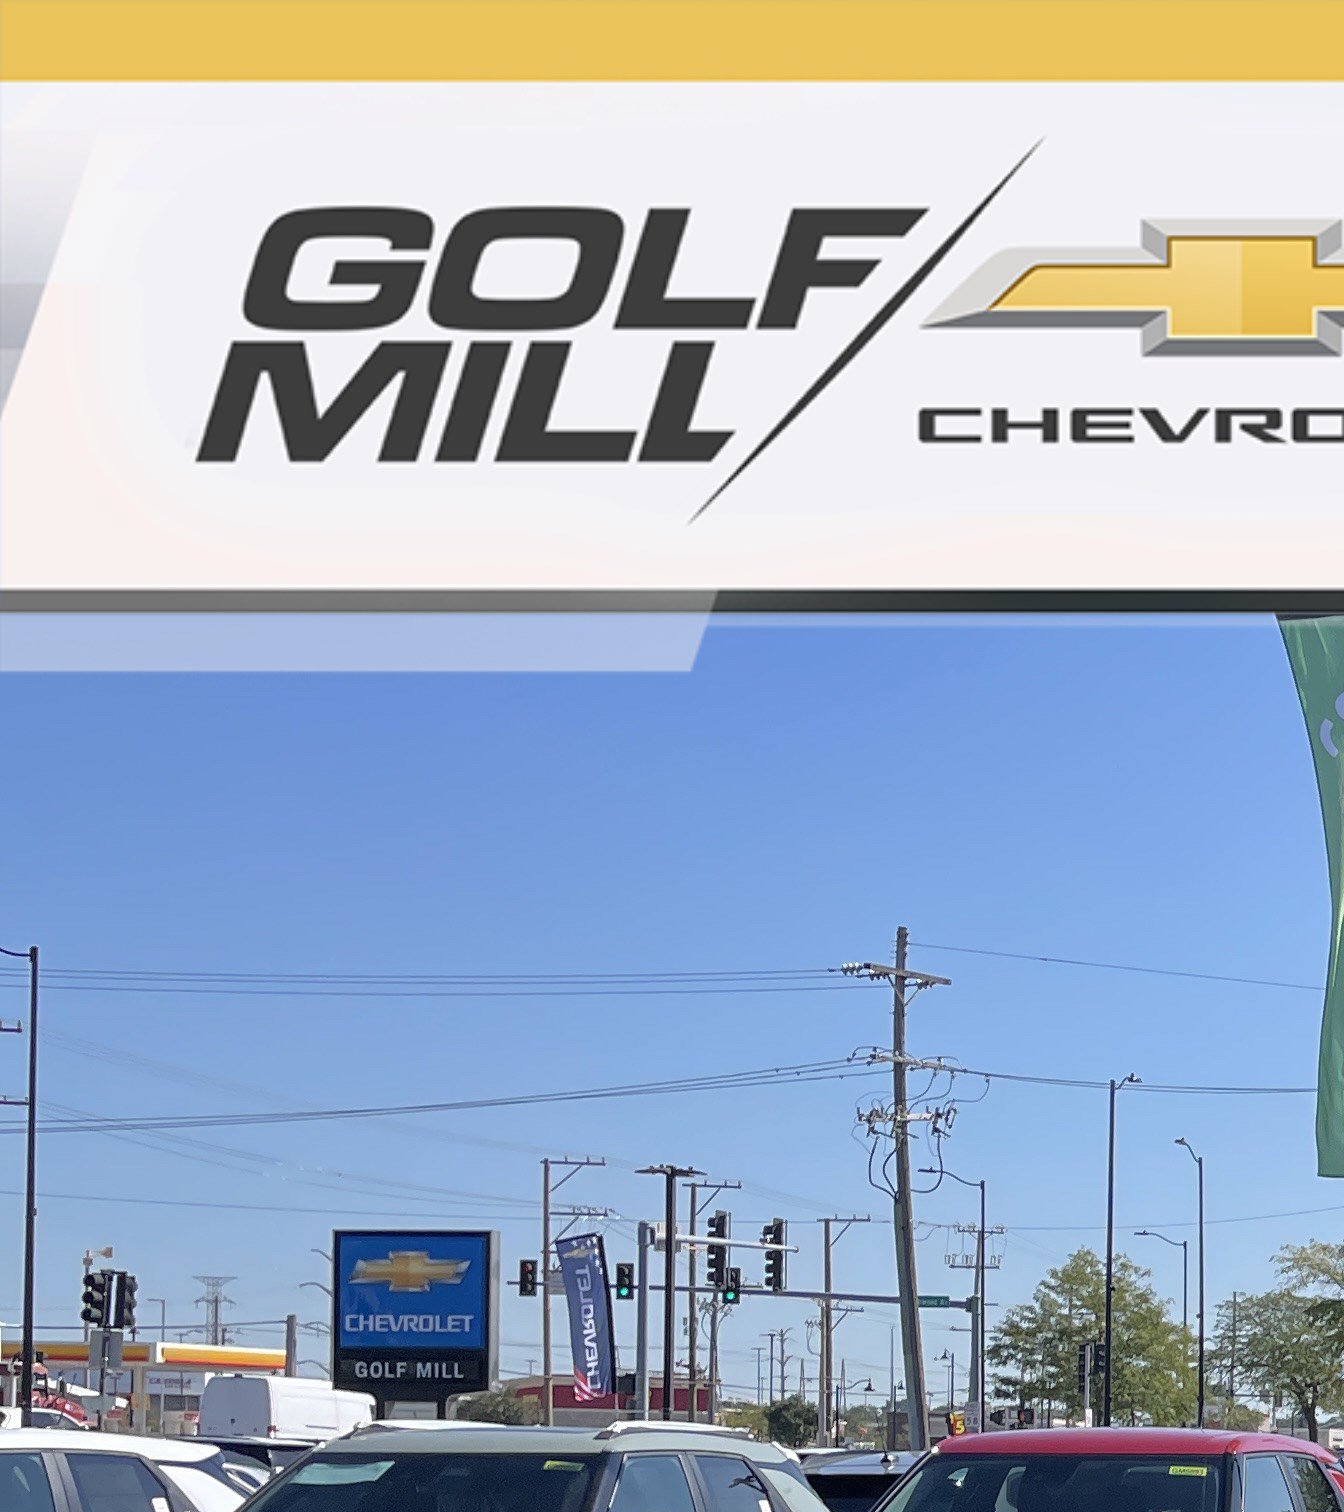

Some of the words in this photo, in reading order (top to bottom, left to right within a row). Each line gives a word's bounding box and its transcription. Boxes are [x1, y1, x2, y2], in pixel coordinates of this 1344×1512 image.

[345, 1314, 474, 1333] CHEVROLET
[355, 1360, 407, 1379] GOLF
[416, 1361, 464, 1379] MILL
